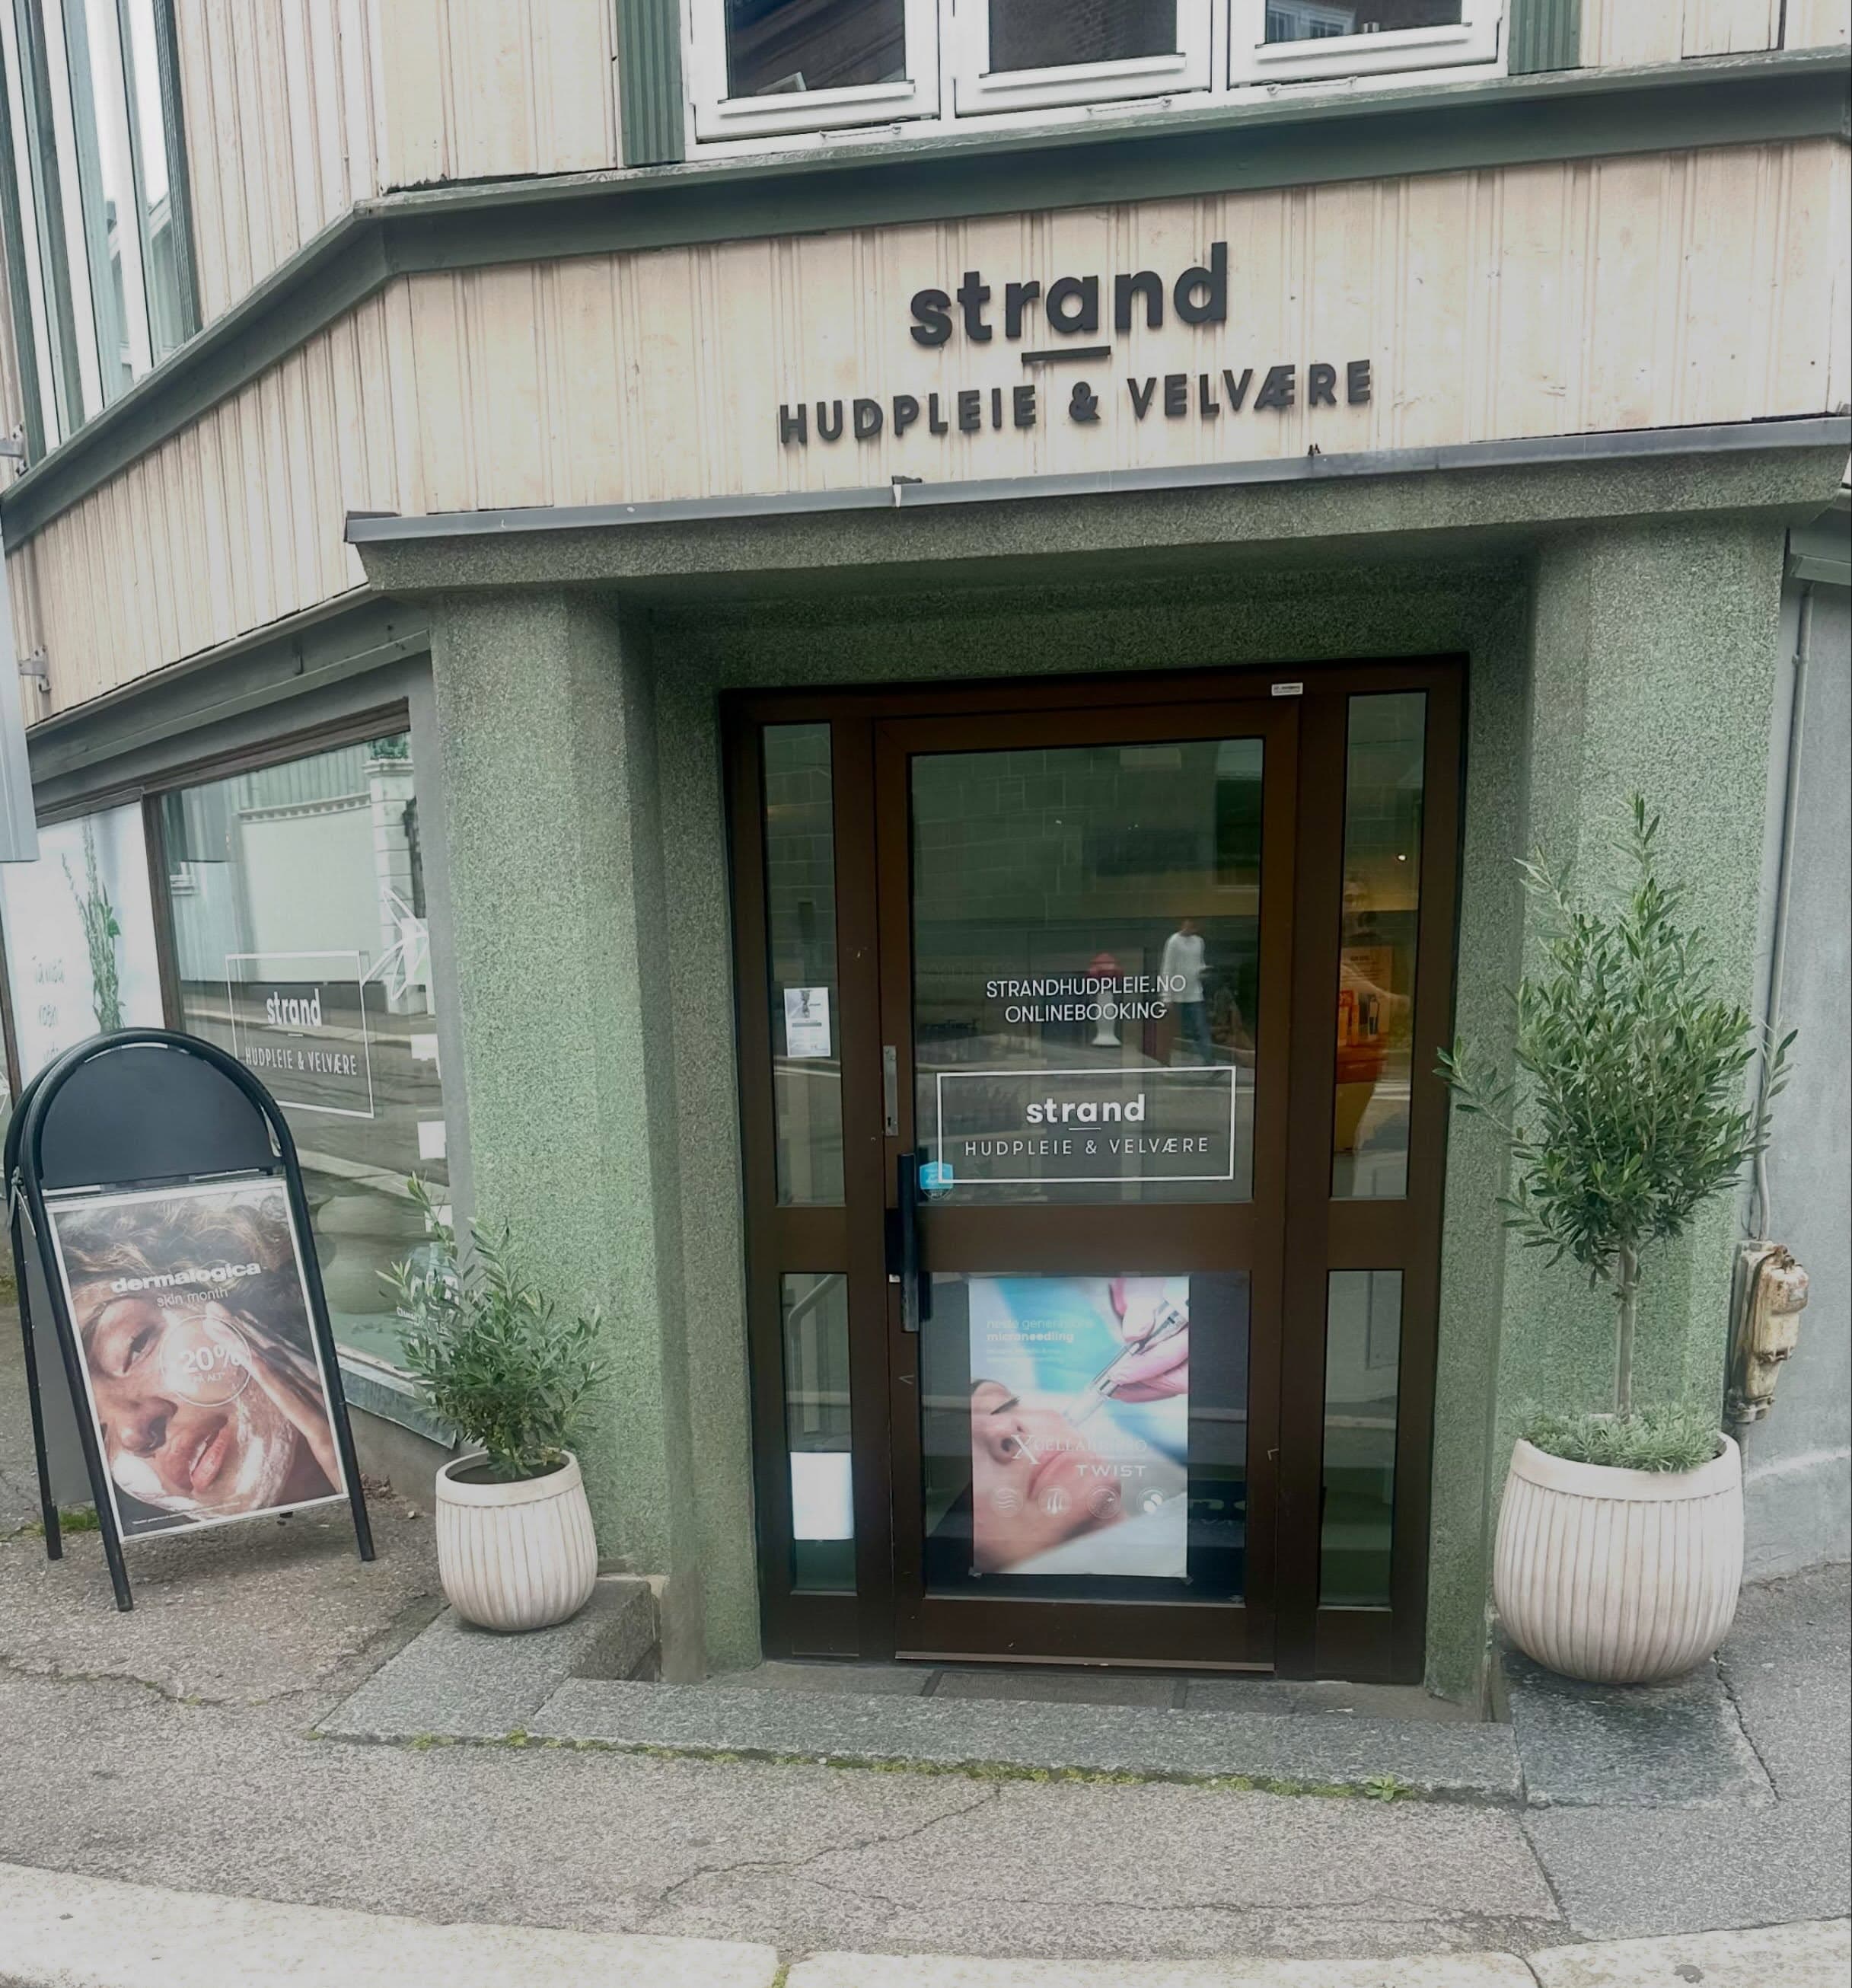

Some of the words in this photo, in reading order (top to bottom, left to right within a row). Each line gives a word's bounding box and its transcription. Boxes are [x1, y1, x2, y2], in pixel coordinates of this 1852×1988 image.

[910, 241, 1227, 346] strand
[779, 385, 1037, 444] HUDPLEIE
[1069, 381, 1101, 423] &
[1127, 359, 1371, 420] VELVÆRE
[987, 975, 1187, 998] STRANDHUDPLEIE.NO
[266, 987, 323, 1027] strand
[1005, 1001, 1168, 1023] ONLINEBOOKING
[245, 1047, 294, 1070] HUDPLEIE
[298, 1050, 305, 1071] &
[307, 1051, 358, 1076] VELVÆRE
[1025, 1093, 1146, 1125] strand
[964, 1139, 1073, 1157] HUDPLEIE
[1085, 1140, 1098, 1155] &
[1108, 1137, 1210, 1154] VELVÆRE
[110, 1262, 262, 1294] dermalogica
[156, 1294, 183, 1308] skin
[187, 1287, 229, 1304] month
[1075, 1464, 1147, 1478] TWIST
